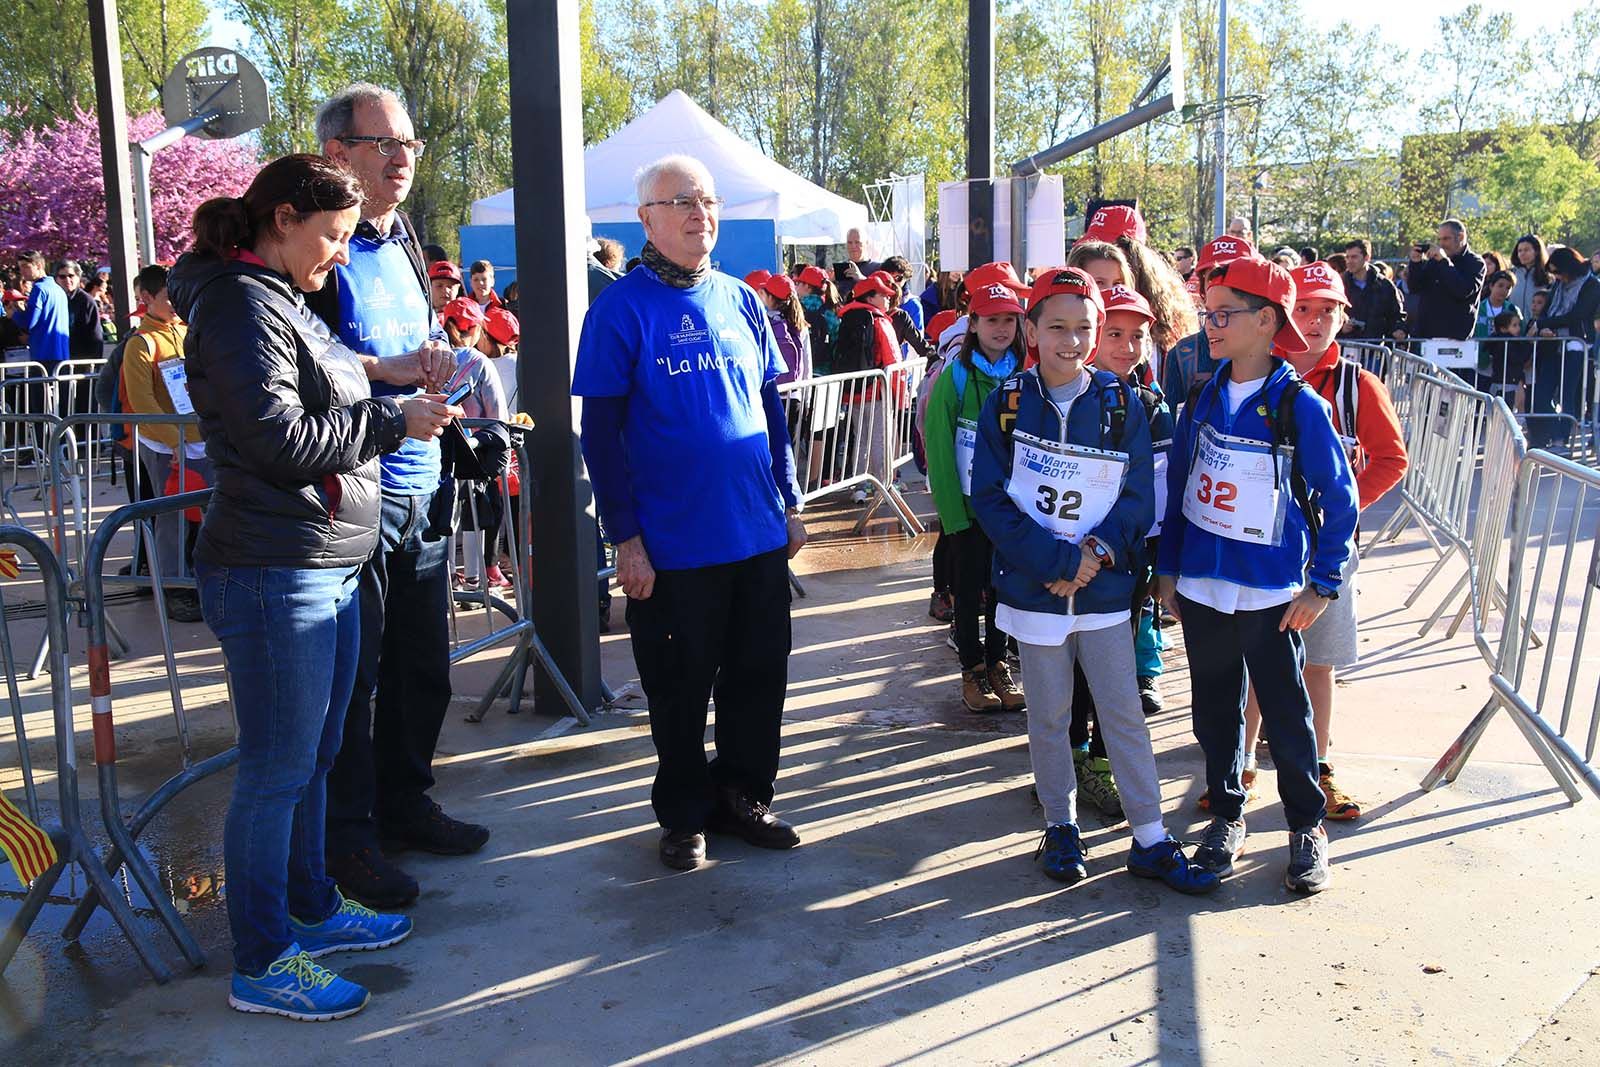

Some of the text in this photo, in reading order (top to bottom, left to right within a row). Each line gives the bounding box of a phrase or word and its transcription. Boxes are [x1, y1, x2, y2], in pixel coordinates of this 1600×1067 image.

[1212, 241, 1238, 251] TOT
[1206, 440, 1231, 461] Marxa
[1040, 454, 1079, 470] Marxa
[1036, 484, 1083, 521] 32
[1197, 472, 1237, 512] 32
